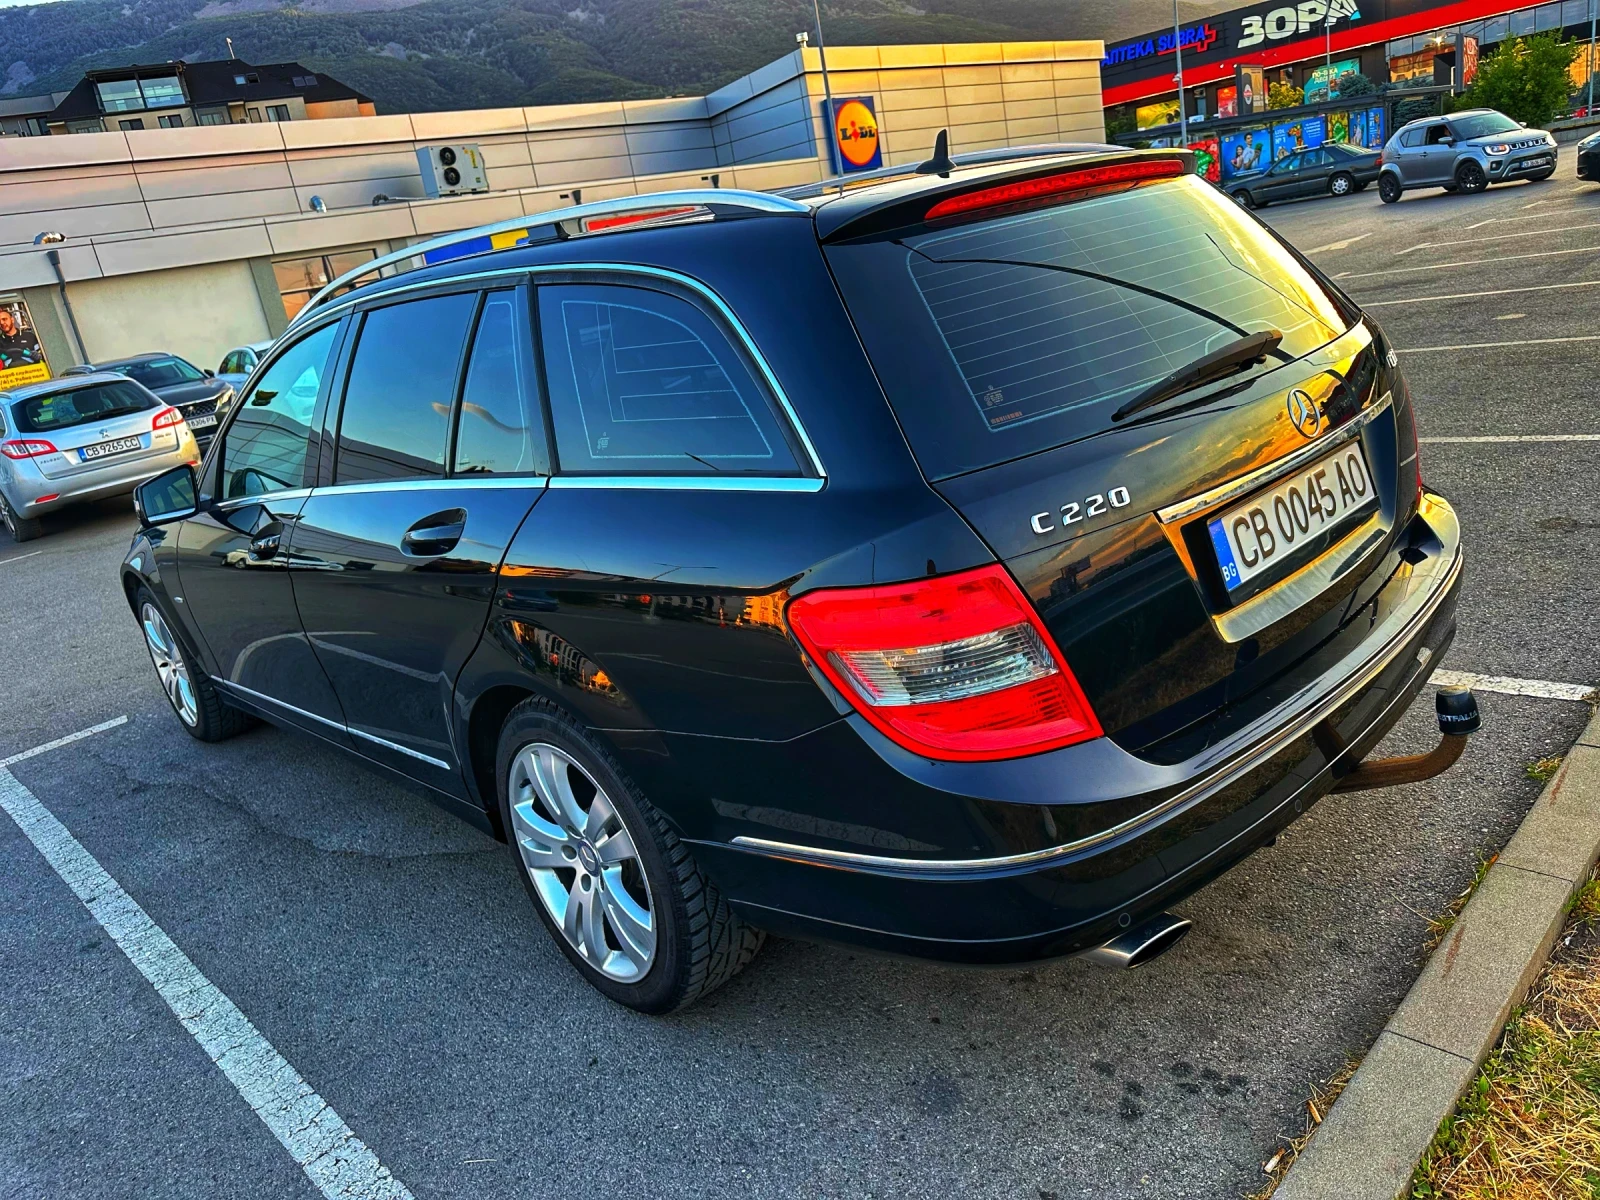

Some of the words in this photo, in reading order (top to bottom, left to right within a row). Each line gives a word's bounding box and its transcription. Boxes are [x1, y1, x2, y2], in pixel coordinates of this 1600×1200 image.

[1101, 39, 1154, 66] АПТЕКА
[1158, 26, 1205, 51] SUBRA
[1237, 0, 1359, 48] ЗОРА
[86, 445, 100, 457] CB
[100, 440, 124, 453] 9265
[124, 438, 138, 449] CC
[1030, 511, 1055, 535] C
[1060, 486, 1131, 526] 220
[1233, 506, 1276, 568] CB
[1274, 469, 1337, 544] 0045
[1334, 452, 1367, 509] AO
[1222, 563, 1237, 582] BG
